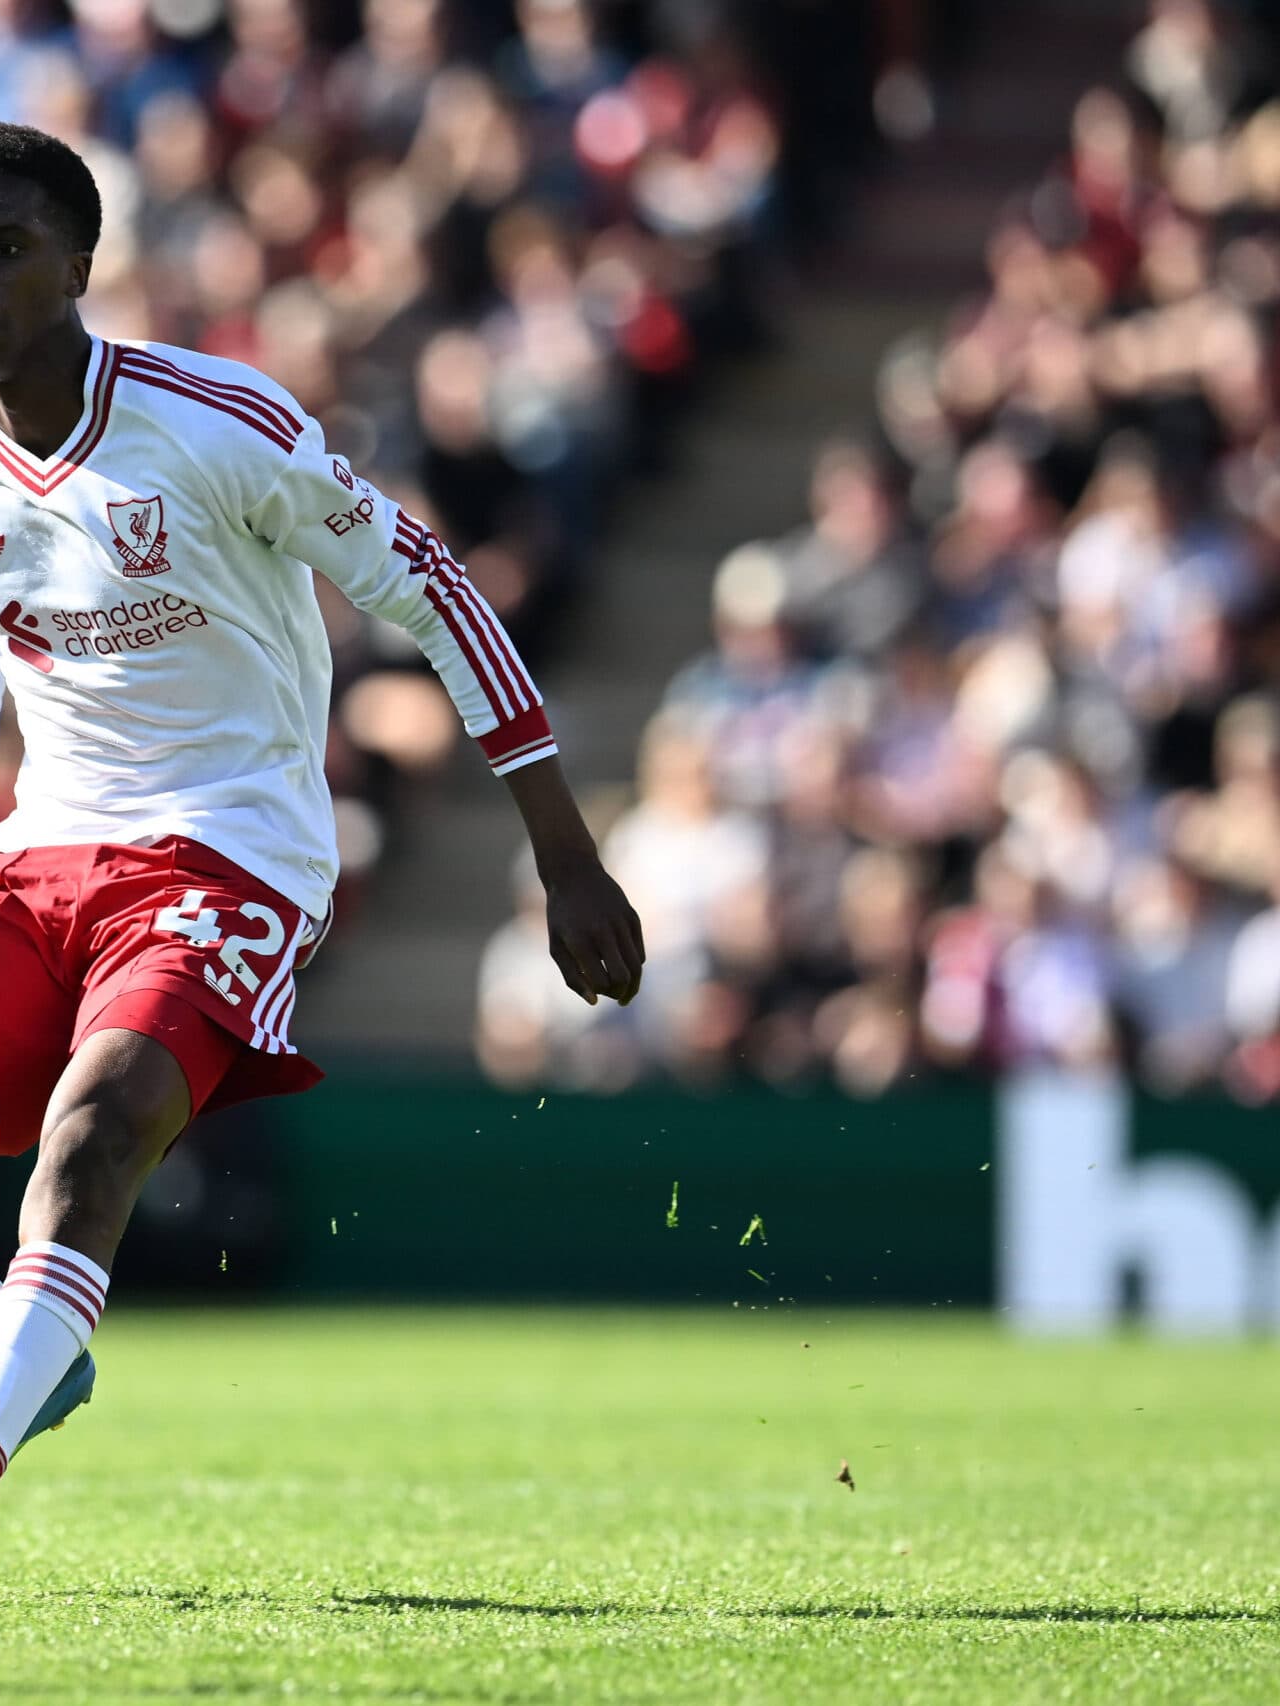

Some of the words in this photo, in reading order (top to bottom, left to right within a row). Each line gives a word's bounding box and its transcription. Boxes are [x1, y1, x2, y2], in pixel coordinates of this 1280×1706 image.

[323, 493, 375, 537] Exp
[120, 545, 143, 567] LIVER
[147, 543, 164, 565] POOL
[65, 604, 209, 657] chartered
[154, 888, 286, 995] 42
